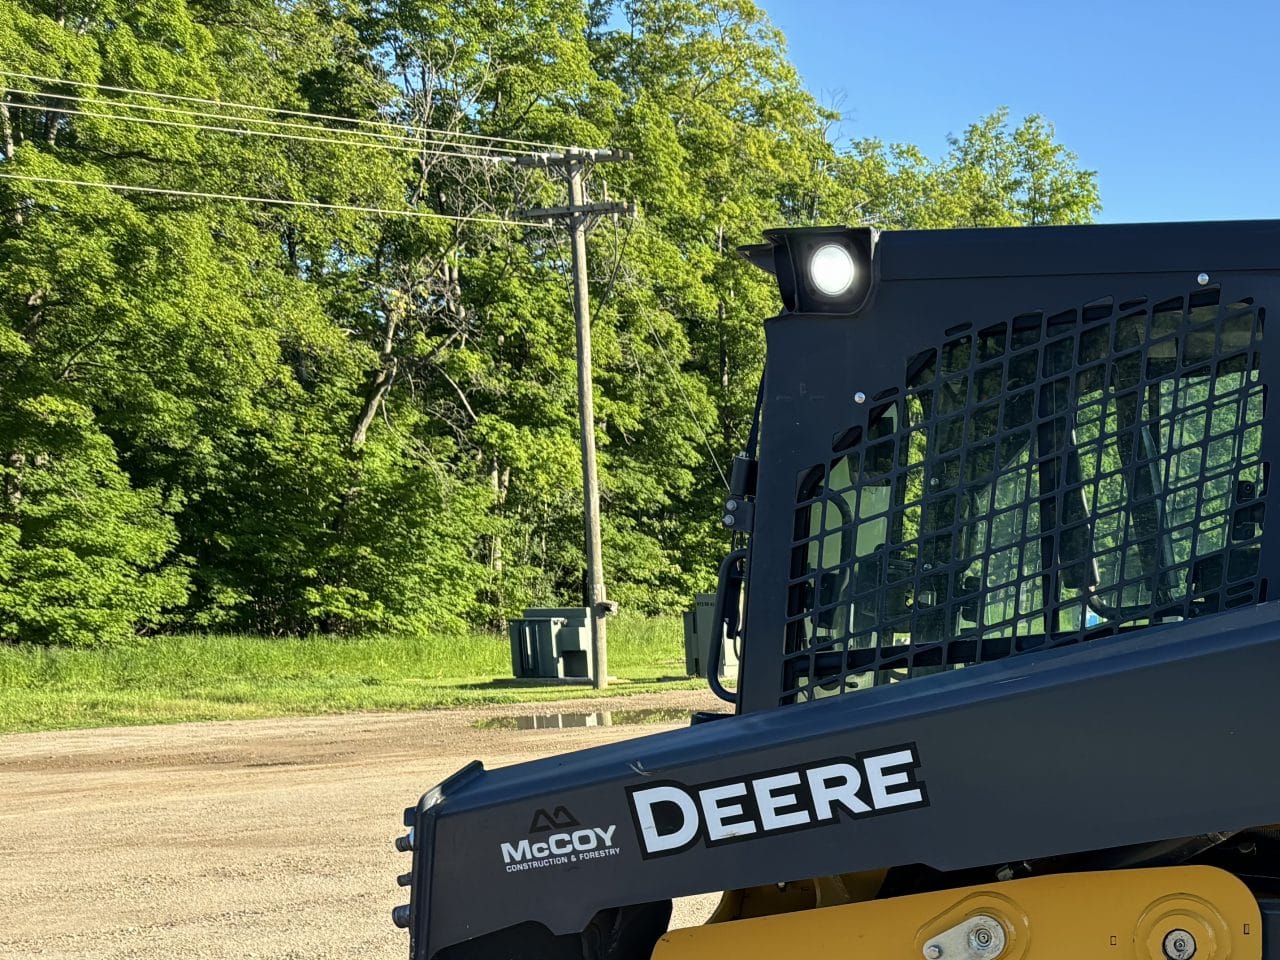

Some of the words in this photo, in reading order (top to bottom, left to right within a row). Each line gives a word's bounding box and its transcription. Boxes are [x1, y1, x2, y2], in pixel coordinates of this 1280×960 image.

[632, 749, 923, 853] DEERE
[500, 824, 617, 863] McCOY
[506, 855, 568, 873] CONSTRUCTION
[579, 847, 621, 861] FORESTRY
